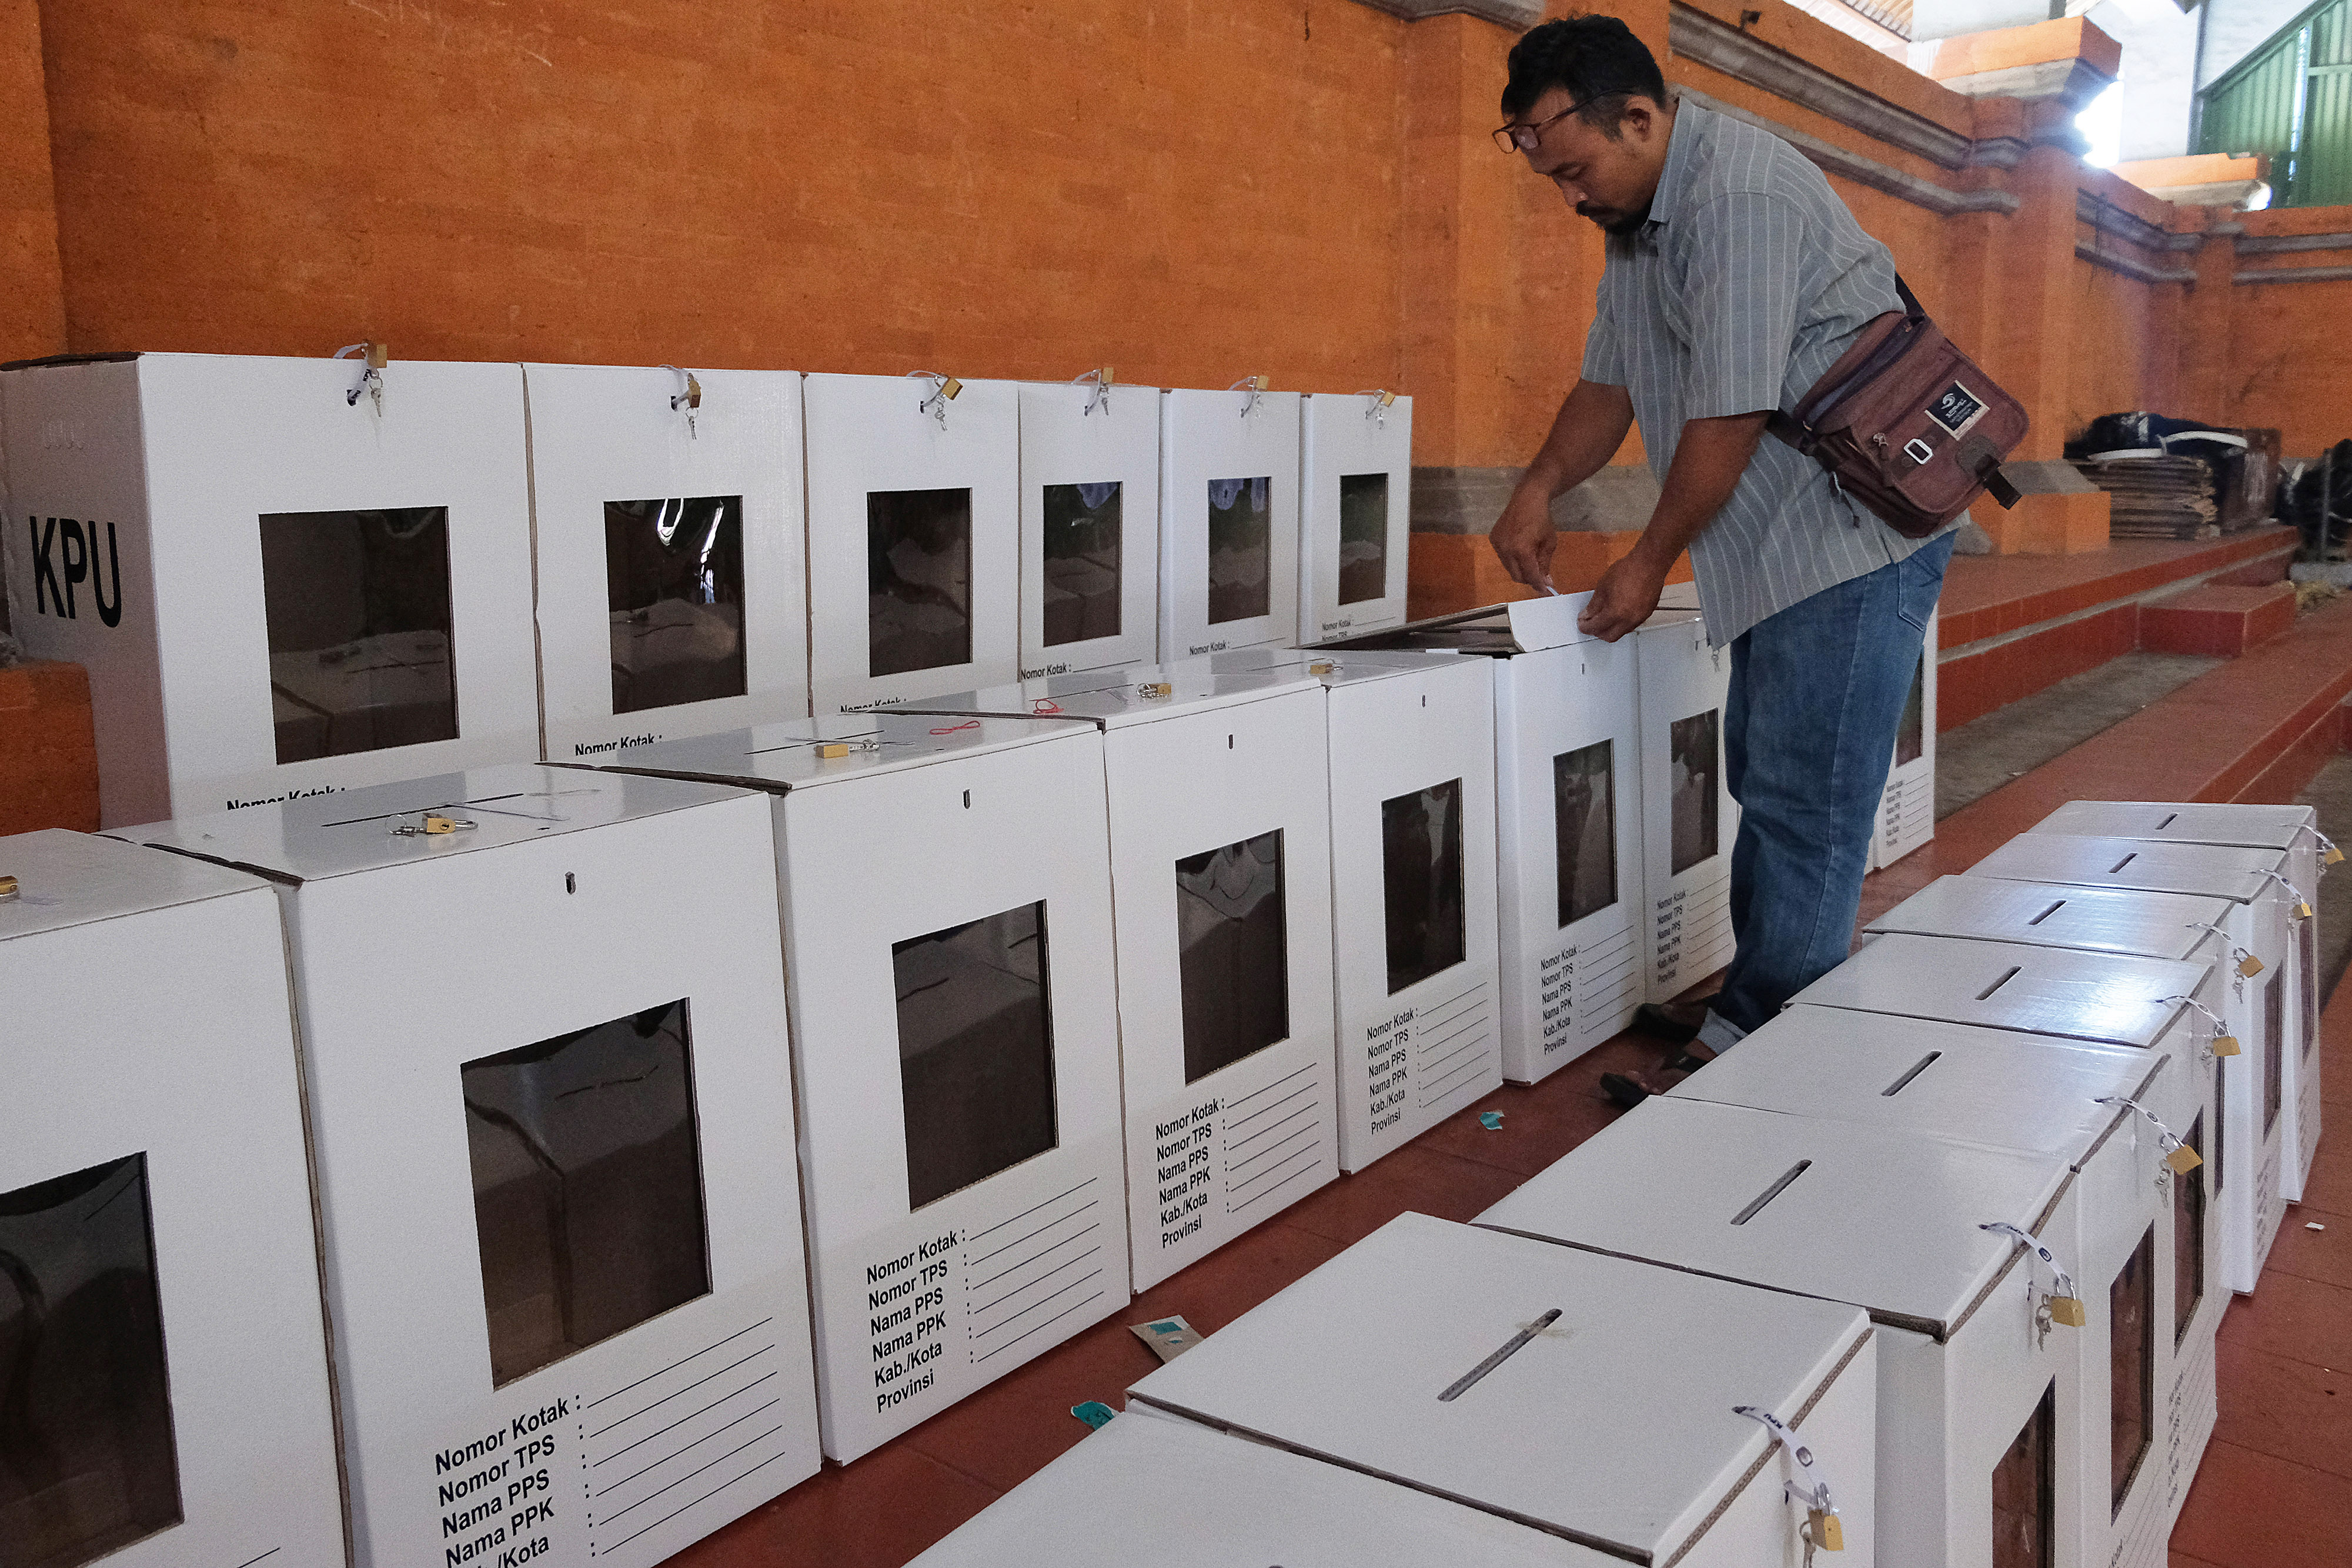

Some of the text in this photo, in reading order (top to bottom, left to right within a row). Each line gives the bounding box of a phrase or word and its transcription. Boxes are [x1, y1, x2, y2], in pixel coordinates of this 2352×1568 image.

[29, 516, 122, 628] KPU
[1190, 645, 1210, 656] Nomor
[1211, 640, 1226, 651] Kotak
[1020, 668, 1045, 680] Nomor
[1047, 663, 1067, 676] Kotak
[575, 733, 654, 756] Nomor Kotak
[1541, 945, 1577, 970] Nomor Kotak
[1542, 963, 1573, 988] Nomor TPS
[1542, 981, 1571, 1005] Nama PPS
[1543, 997, 1572, 1021] Nama PPK
[1367, 1021, 1392, 1041] Nomor
[1394, 1008, 1414, 1028] Kotak
[1368, 1039, 1392, 1059] Nomor
[1394, 1029, 1408, 1046] TPS
[1544, 1033, 1566, 1055] Provinsi
[1369, 1060, 1389, 1078] Nama
[1391, 1049, 1406, 1067] PPS
[1369, 1079, 1390, 1097] Nama
[1392, 1066, 1407, 1085] PPK
[1156, 1115, 1189, 1140] Nomor
[1192, 1098, 1219, 1124] Kotak
[1371, 1089, 1405, 1116] Kab./Kota
[1371, 1108, 1400, 1135] Provinsi
[1157, 1136, 1190, 1162] Nomor
[1192, 1123, 1211, 1144] TPS
[1158, 1161, 1186, 1183] Nama
[1189, 1146, 1208, 1168] PPS
[1160, 1182, 1187, 1205] Nama
[1190, 1166, 1211, 1189] PPK
[1161, 1192, 1207, 1227] Kab./Kota
[1162, 1214, 1201, 1248] Provinsi
[867, 1252, 914, 1285] Nomor
[919, 1231, 957, 1262] Kotak
[868, 1277, 917, 1310] Nomor
[920, 1260, 947, 1285] TPS
[871, 1306, 911, 1336] Nama
[915, 1288, 943, 1315] PPS
[873, 1332, 913, 1362] Nama
[917, 1310, 946, 1340] PPK
[875, 1343, 942, 1388] Kab./Kota
[877, 1369, 933, 1413] Provinsi
[436, 1429, 506, 1476] Nomor
[512, 1398, 569, 1440] Kotak
[1764, 1413, 1783, 1429] KPU
[439, 1459, 509, 1507] Nomor
[514, 1435, 554, 1469] TPS
[442, 1497, 502, 1539] Nama
[508, 1469, 549, 1506] PPS
[446, 1527, 506, 1568] Nama
[511, 1496, 554, 1536] PPK
